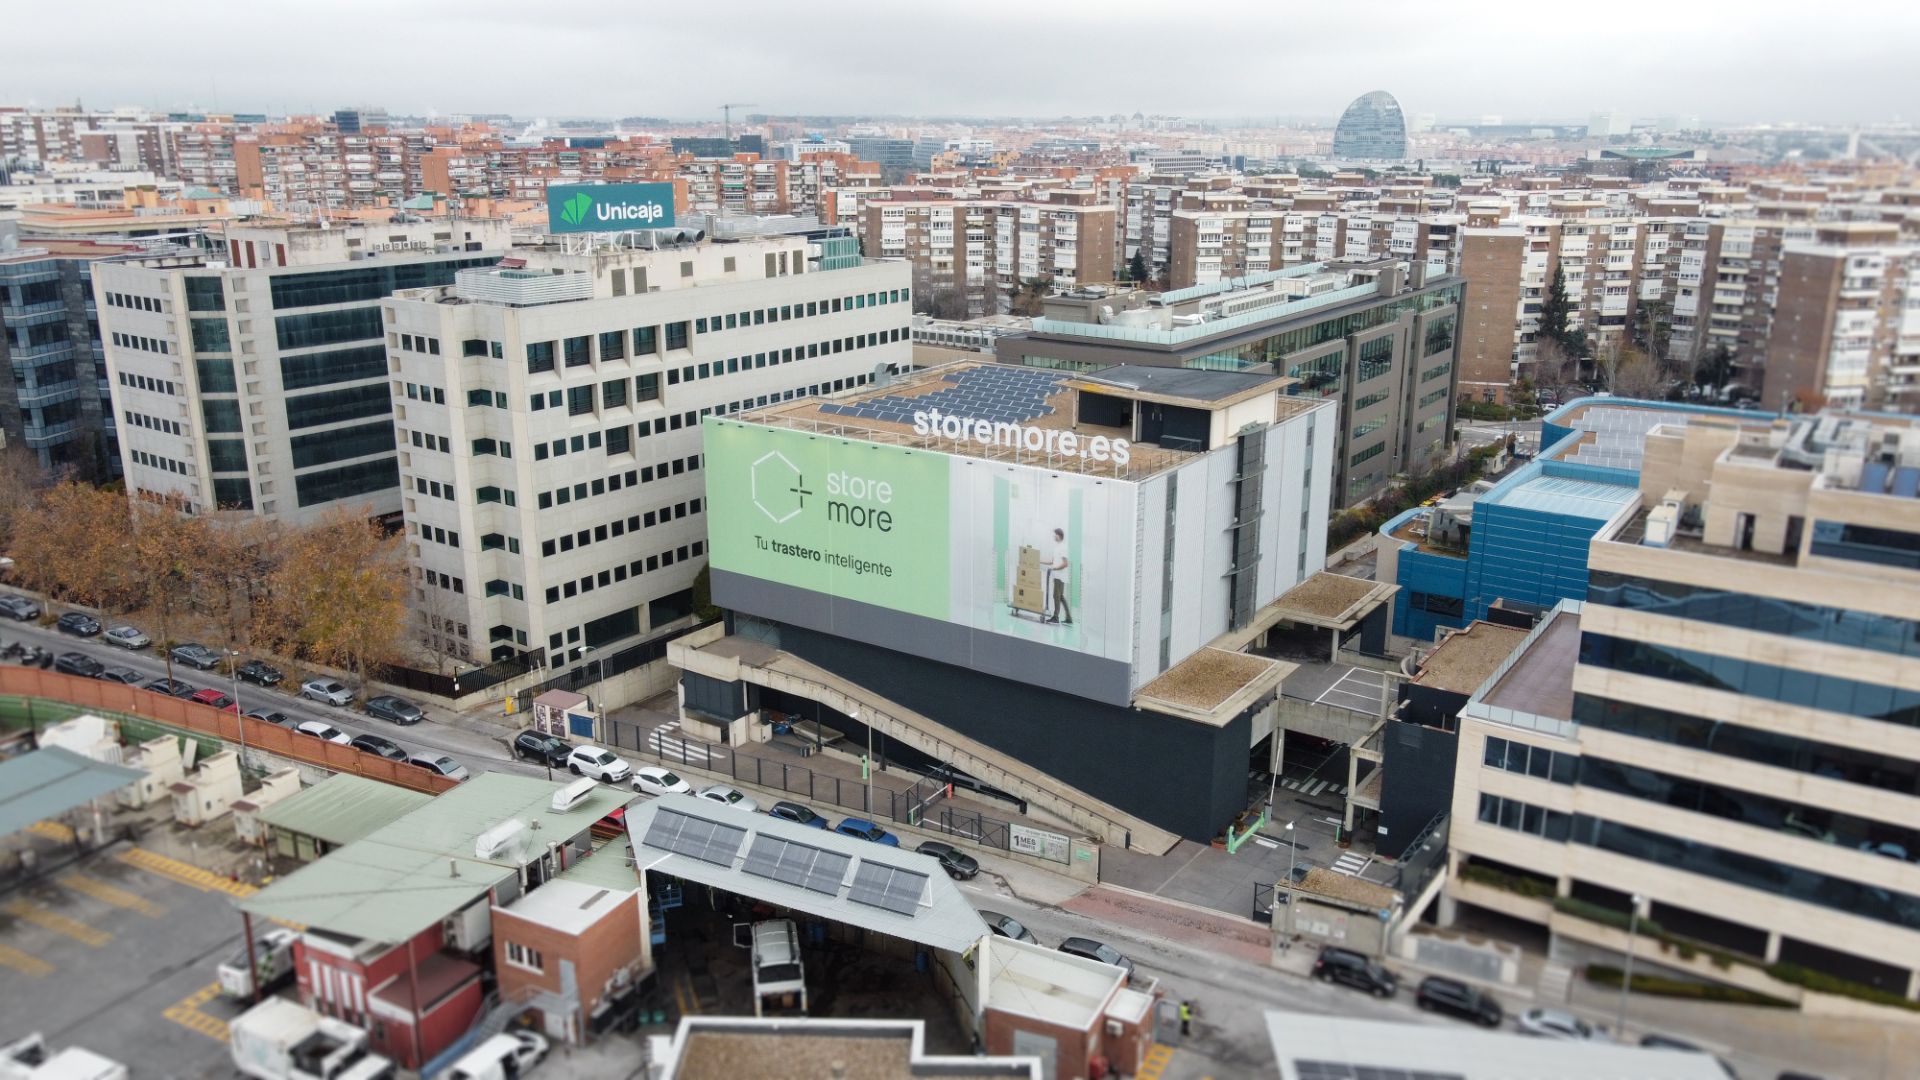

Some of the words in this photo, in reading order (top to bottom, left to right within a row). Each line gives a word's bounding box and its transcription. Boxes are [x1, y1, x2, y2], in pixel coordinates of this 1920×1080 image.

[596, 201, 663, 223] Unicaja
[913, 408, 1130, 465] storemore.es
[827, 470, 893, 504] store
[828, 499, 893, 533] more
[754, 535, 768, 551] Tu
[771, 540, 821, 562] trastero
[824, 549, 893, 577] inteligente
[1013, 835, 1020, 846] 1
[1020, 836, 1036, 845] MES
